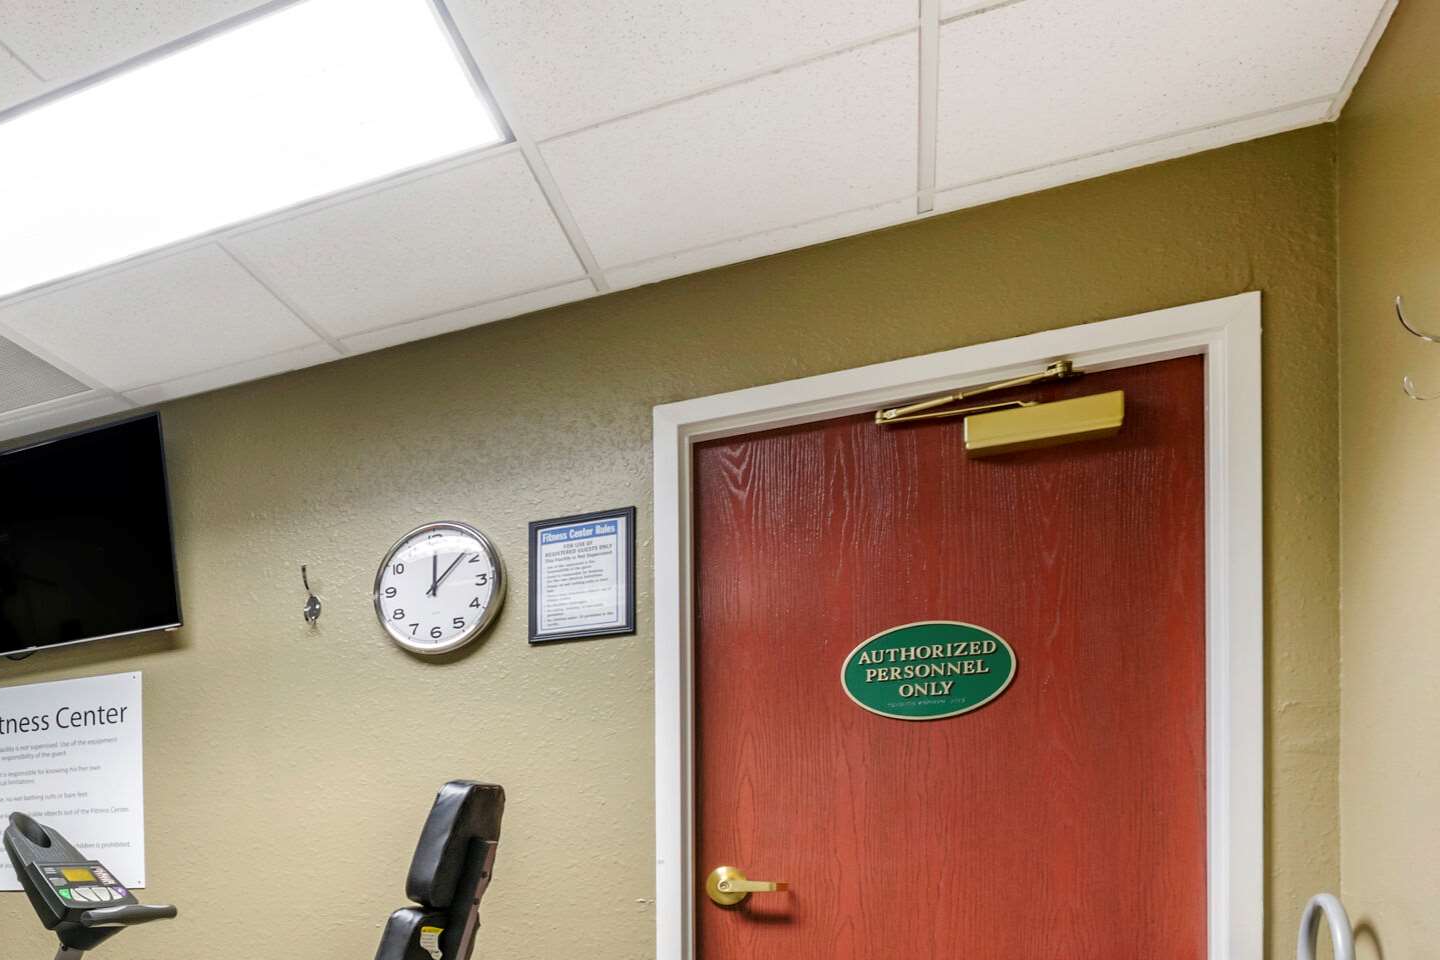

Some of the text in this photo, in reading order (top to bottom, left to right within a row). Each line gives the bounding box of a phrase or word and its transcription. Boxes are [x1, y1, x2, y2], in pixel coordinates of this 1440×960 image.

[542, 522, 616, 543] Fitness Center Rules
[392, 563, 404, 575] 10
[475, 574, 488, 586] 3
[385, 586, 397, 598] 9
[469, 597, 480, 608] 4
[392, 608, 405, 620] 8
[452, 617, 465, 629] 5
[409, 623, 419, 636] 7
[430, 626, 442, 638] 6
[858, 640, 997, 665] AUTHORIZED
[865, 659, 990, 682] PERSONNEL
[898, 680, 954, 698] ONLY
[56, 706, 128, 729] Center
